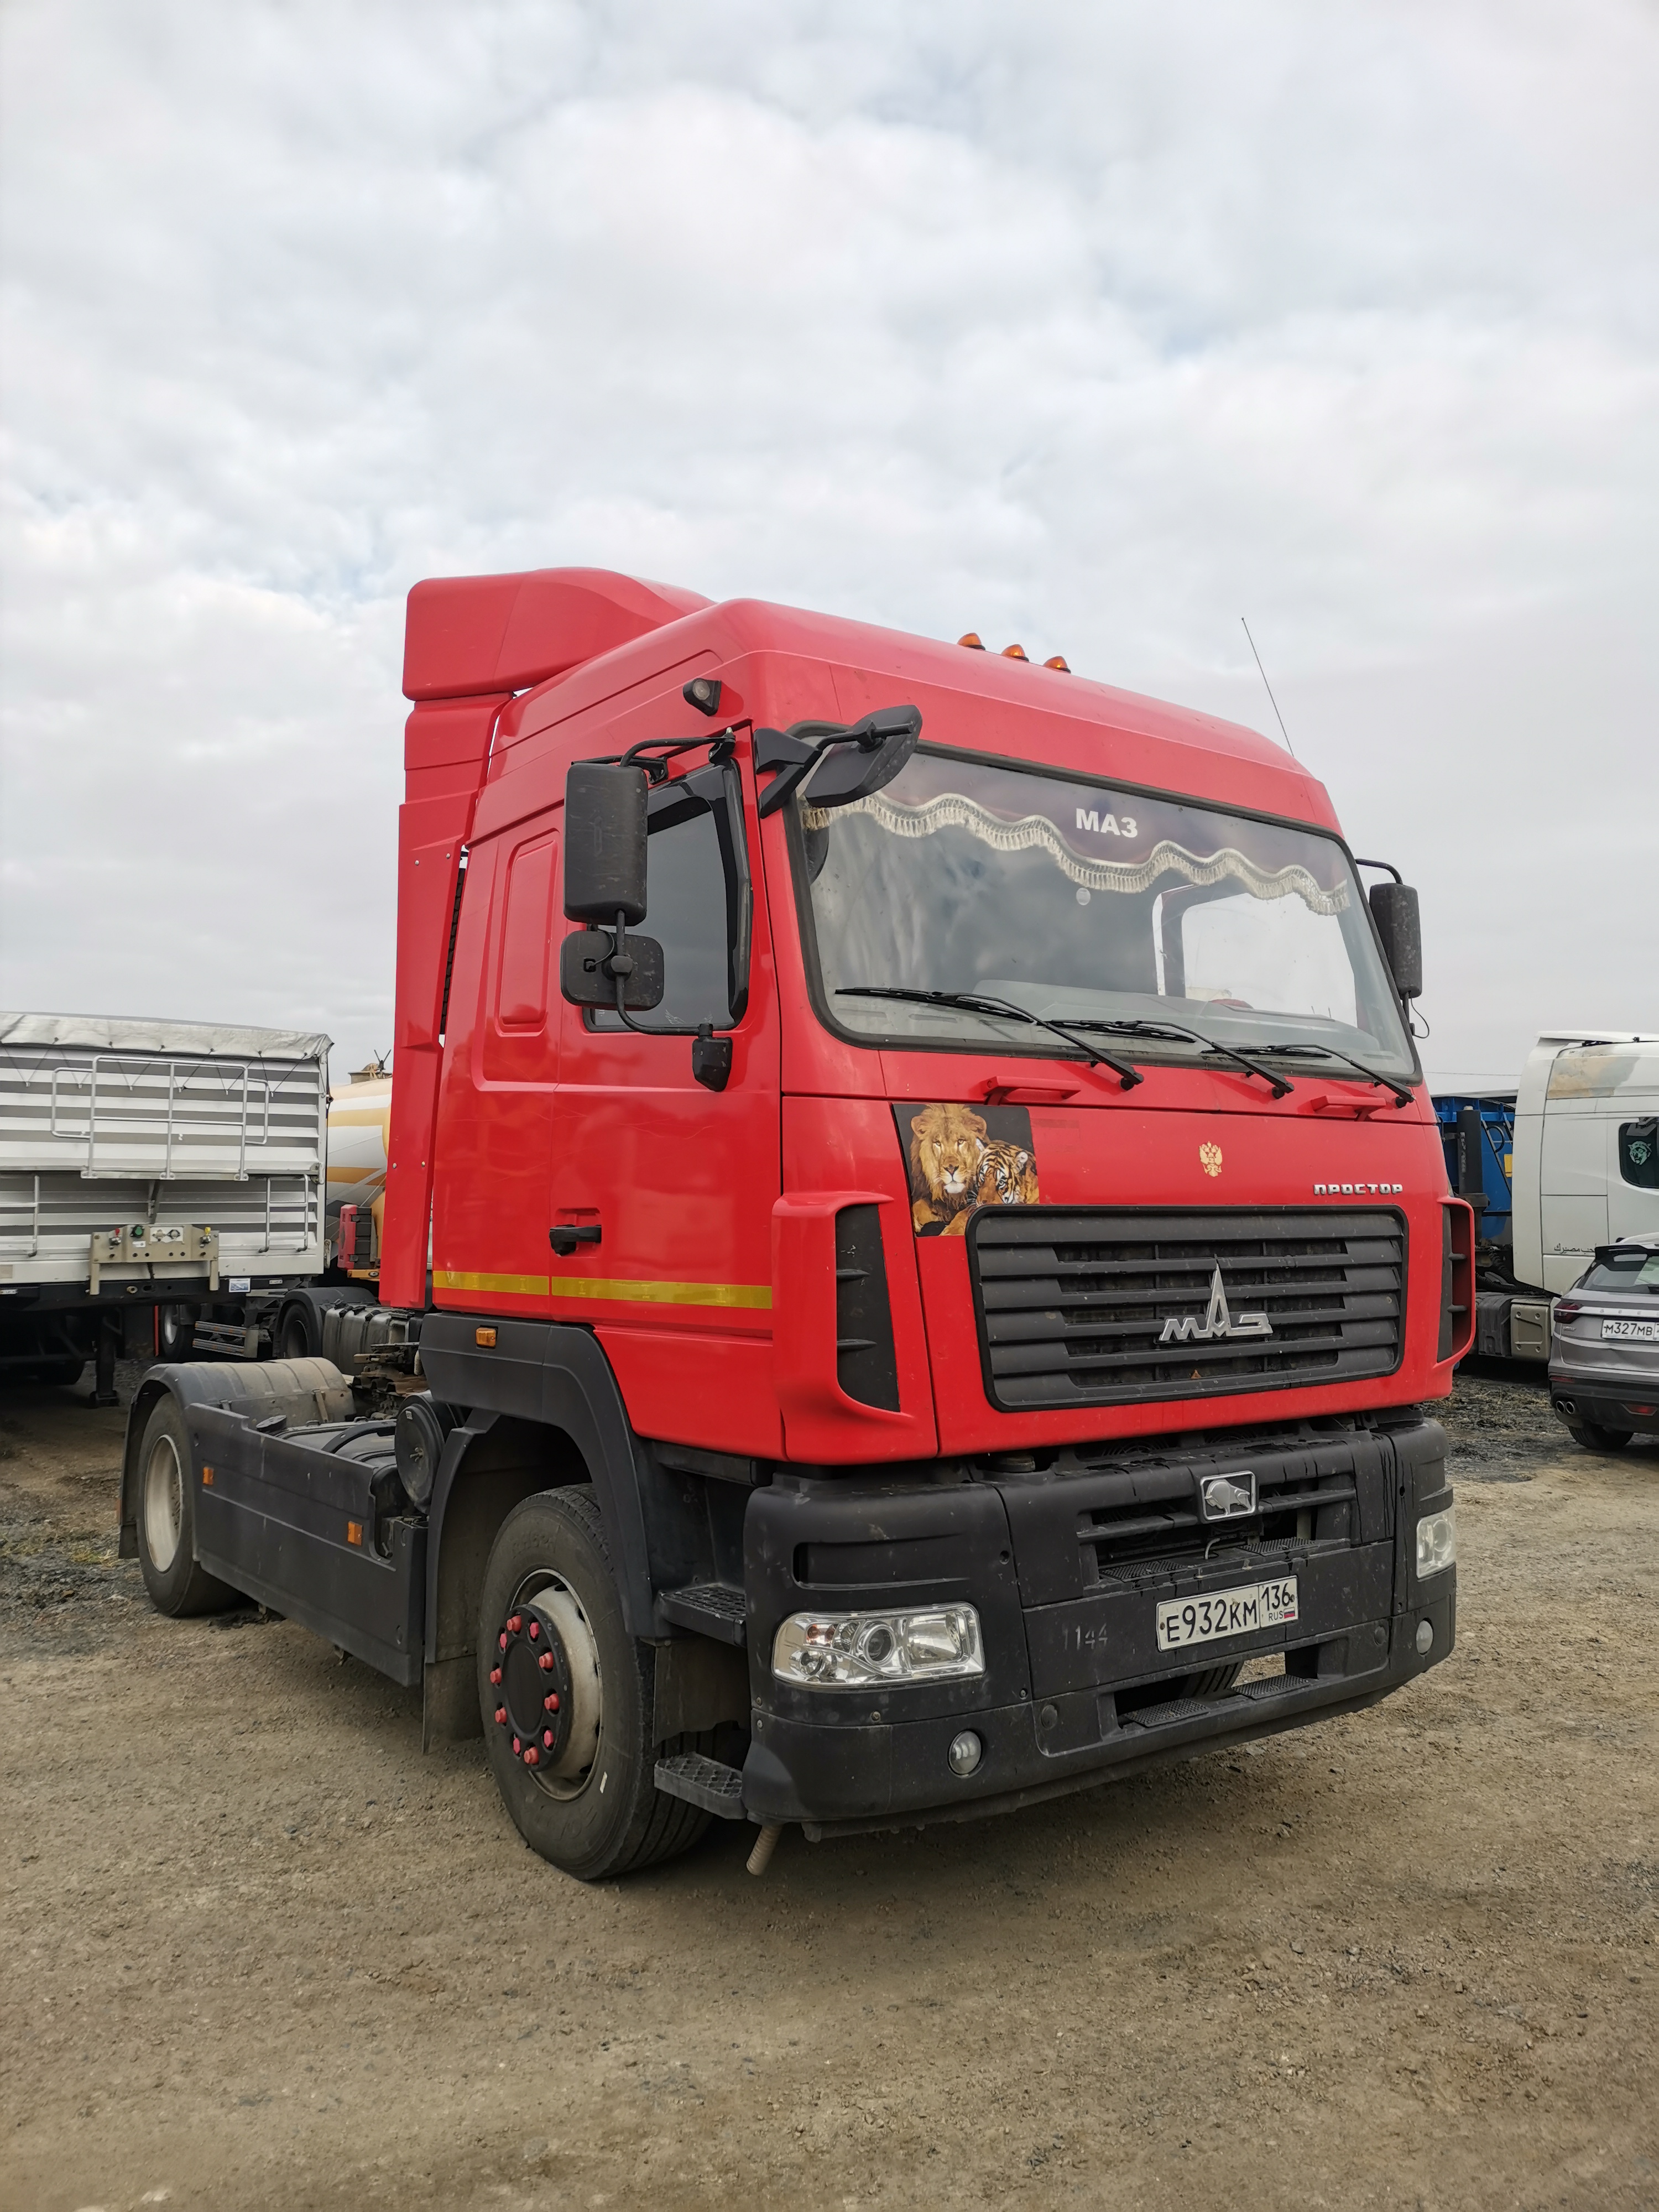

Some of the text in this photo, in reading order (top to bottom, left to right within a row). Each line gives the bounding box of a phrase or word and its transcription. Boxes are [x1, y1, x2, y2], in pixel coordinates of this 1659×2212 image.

[1076, 807, 1138, 838] МАЗ
[1313, 1183, 1404, 1195] ПРОСТОР
[1166, 1582, 1291, 1642] Е932КМ 136
[1268, 1610, 1284, 1622] RUS
